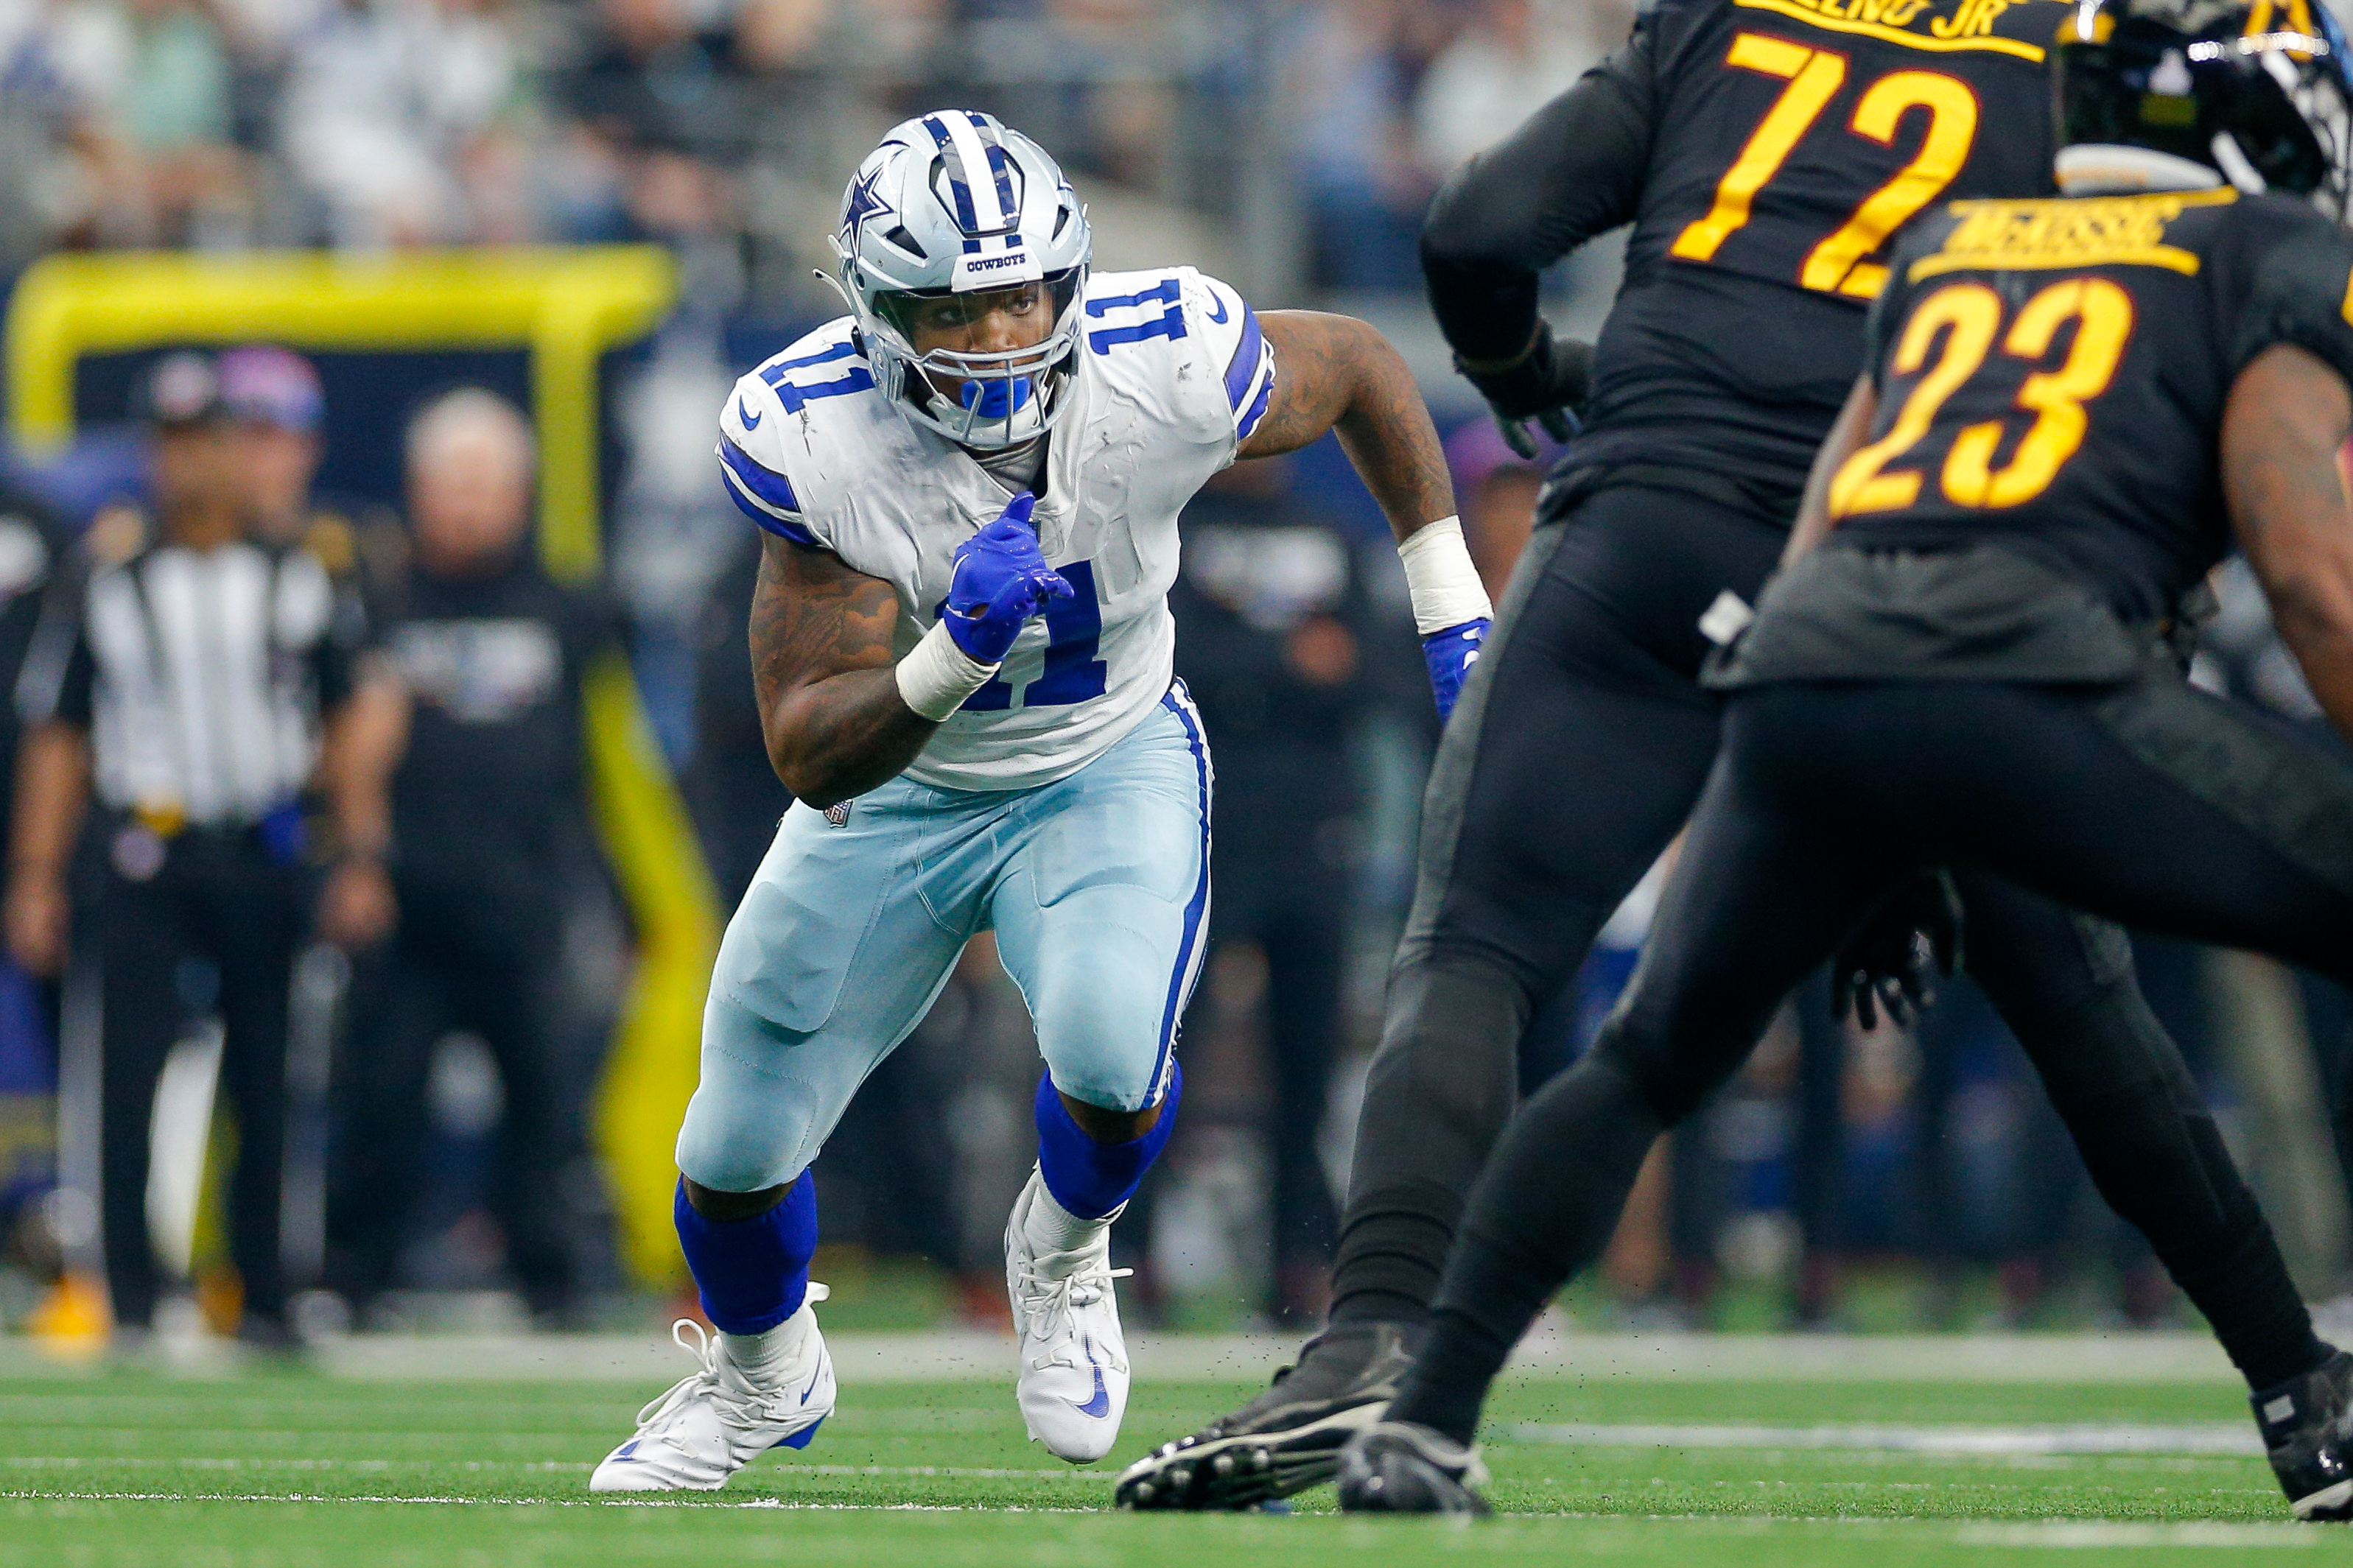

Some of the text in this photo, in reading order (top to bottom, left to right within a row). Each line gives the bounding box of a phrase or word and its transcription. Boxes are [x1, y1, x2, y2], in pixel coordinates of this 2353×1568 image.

[1792, 0, 2008, 38] NO JR
[1666, 31, 1982, 300] 72
[967, 253, 1026, 273] COWBOYS
[1085, 278, 1188, 356] 11
[758, 341, 876, 415] 11
[1826, 275, 2139, 522] 23
